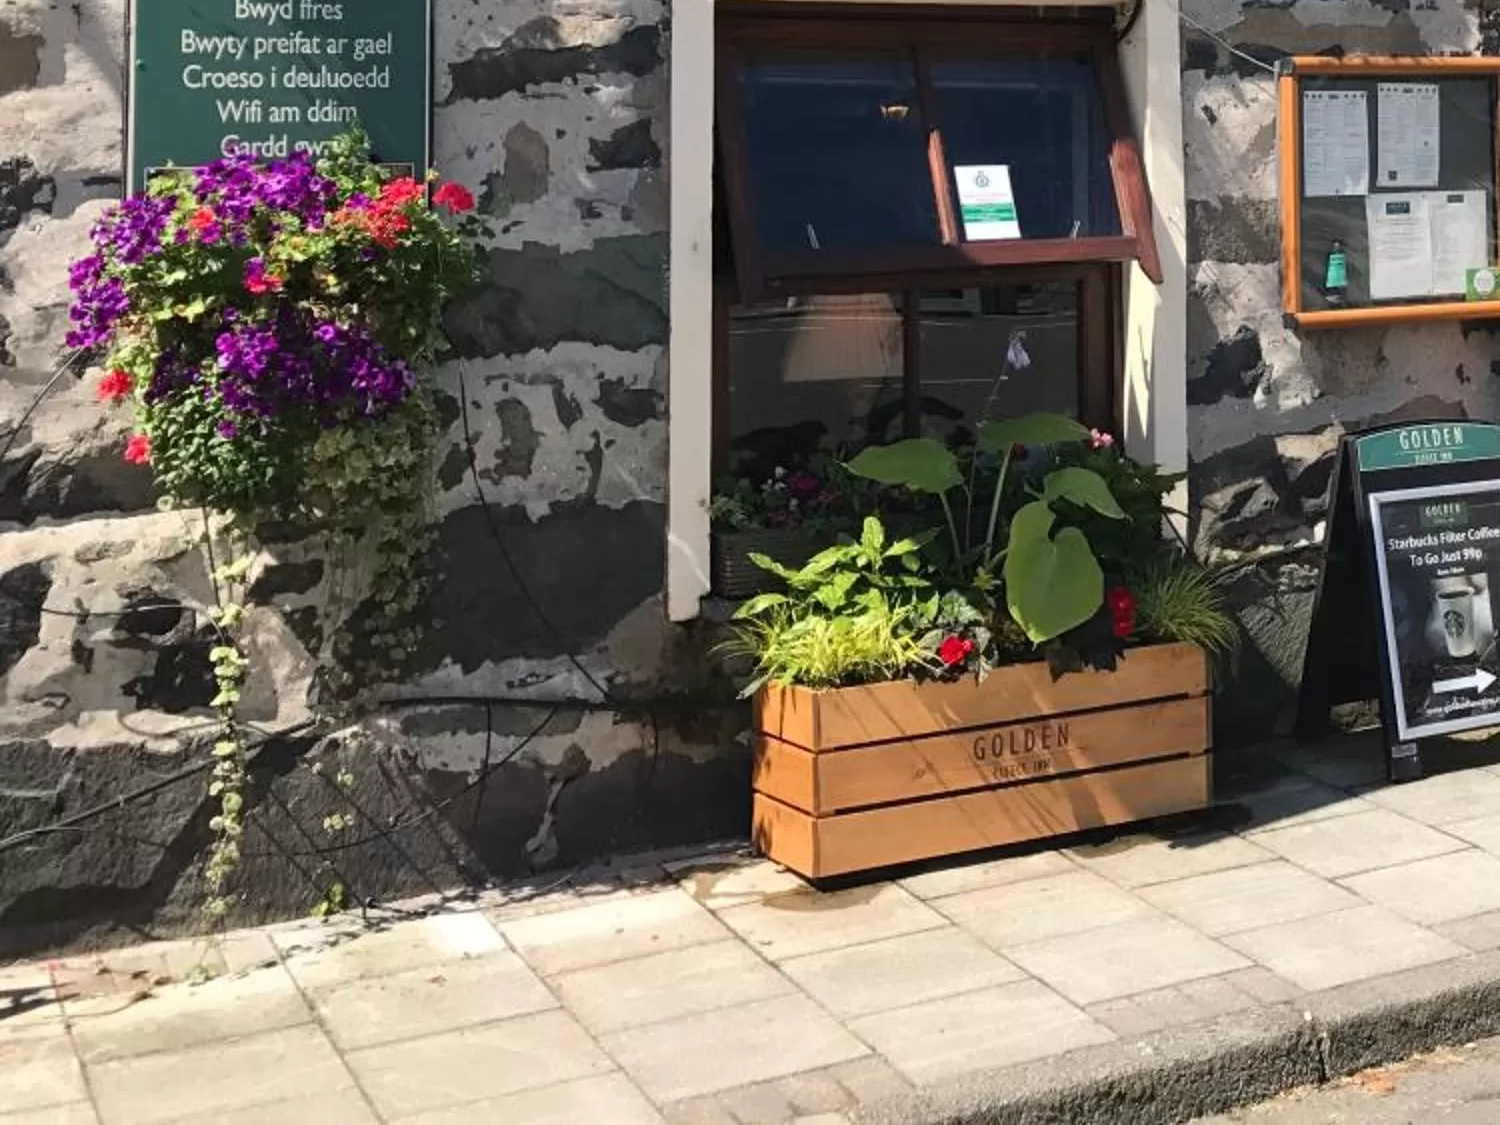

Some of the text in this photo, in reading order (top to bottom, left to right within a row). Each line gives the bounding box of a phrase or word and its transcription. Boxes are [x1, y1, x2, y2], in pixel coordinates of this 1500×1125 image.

[181, 29, 392, 62] Bwyty preifat ar gael
[182, 65, 390, 89] Croeso i deuluoedd
[216, 99, 358, 124] Wifi am ddim
[220, 133, 287, 158] Gardd
[1400, 426, 1463, 451] GOLDEN
[1388, 526, 1500, 552] Starbucks Filter Coffee
[1410, 547, 1483, 567] To Go Just 99p
[973, 721, 1069, 761] GOLDEN
